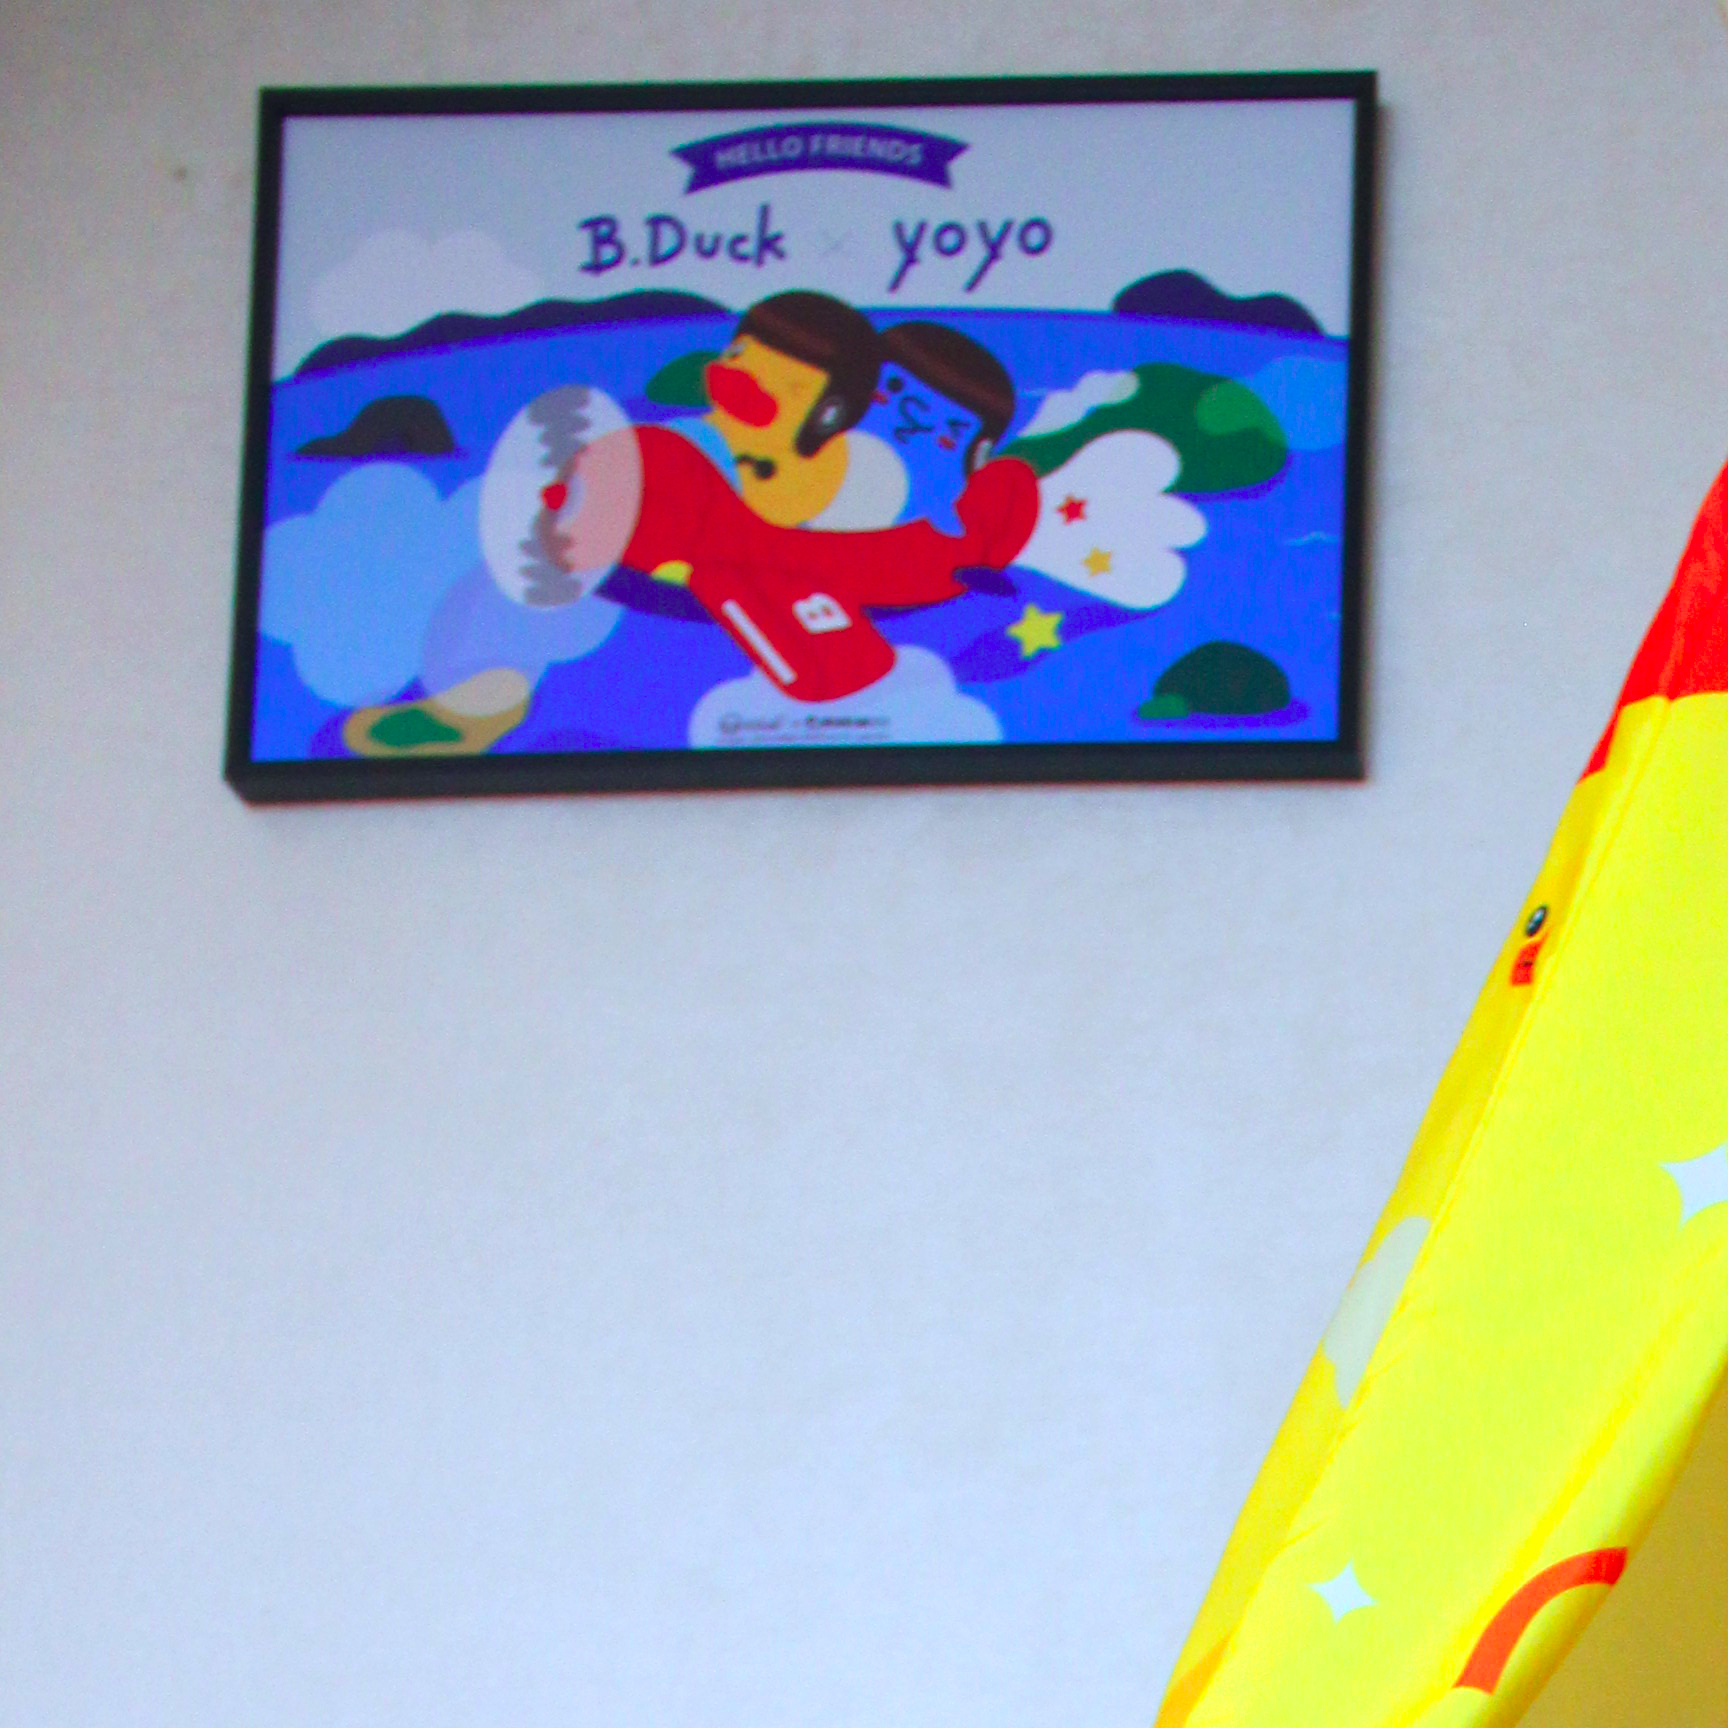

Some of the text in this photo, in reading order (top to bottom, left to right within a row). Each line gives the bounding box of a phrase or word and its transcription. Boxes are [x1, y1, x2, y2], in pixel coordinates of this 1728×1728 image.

[715, 132, 924, 170] HELLO FRIENDS
[577, 202, 788, 276] B.Duck
